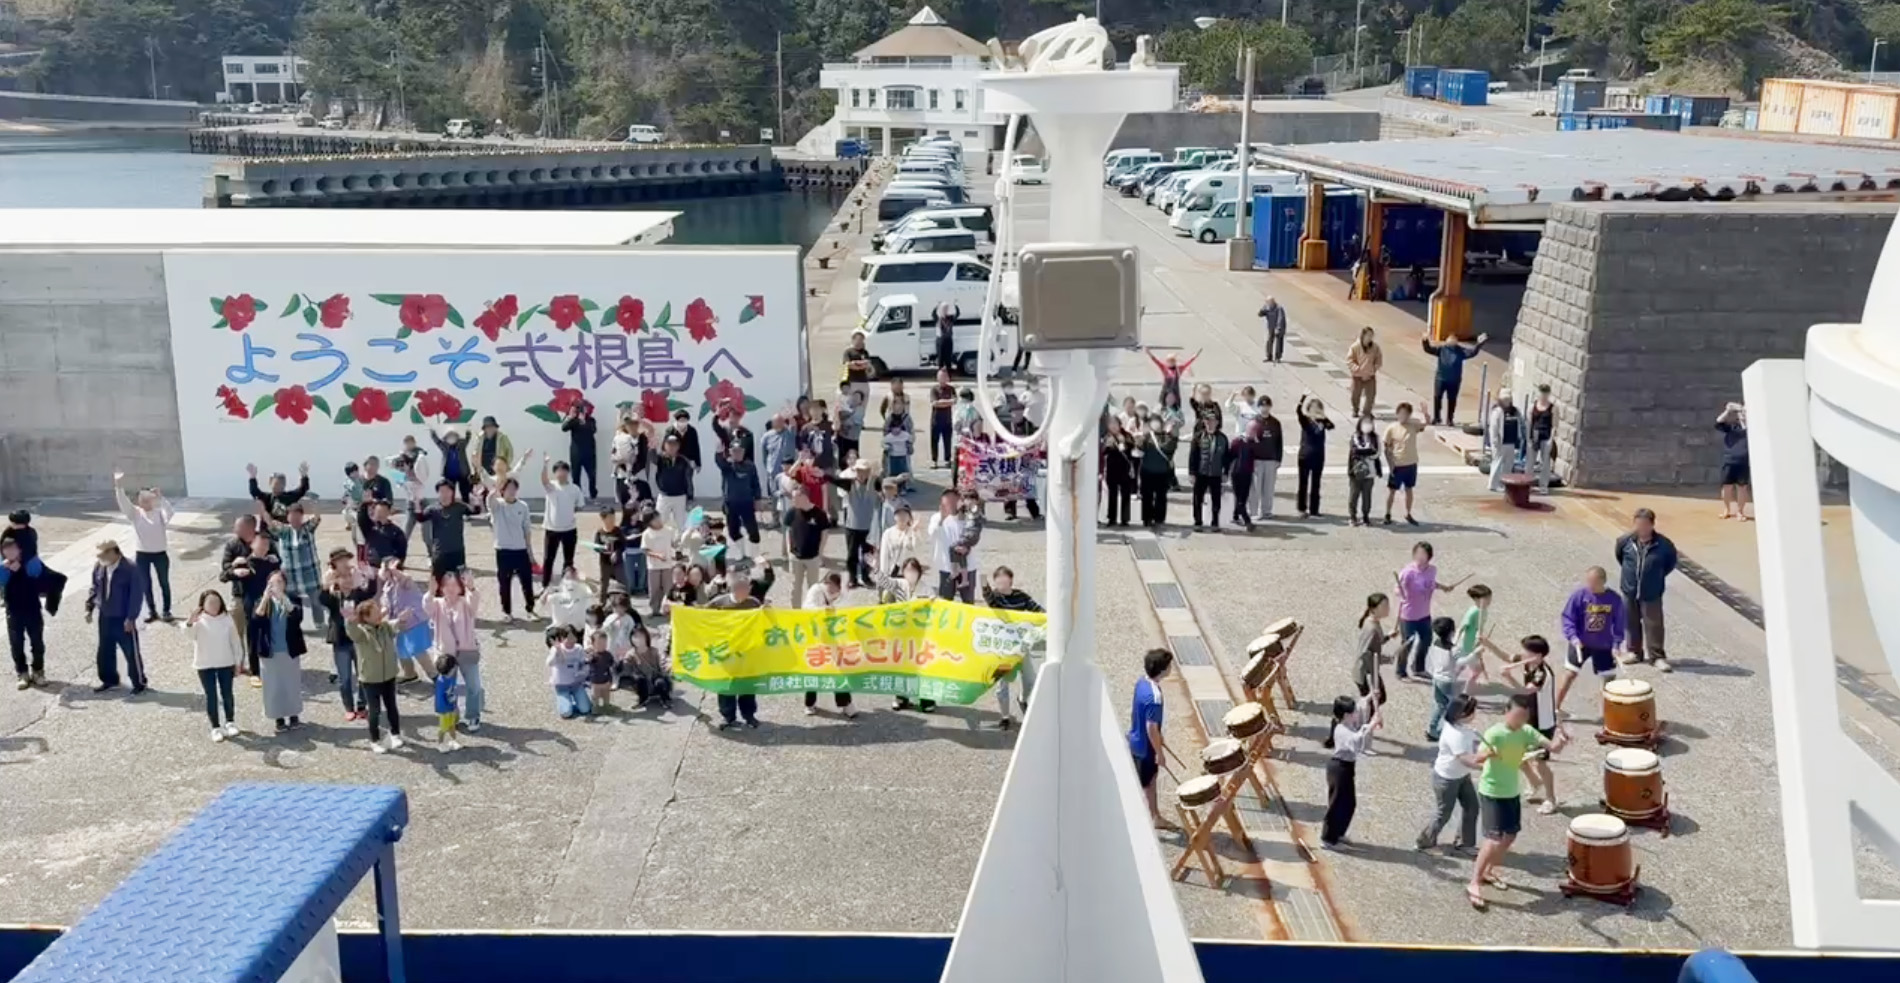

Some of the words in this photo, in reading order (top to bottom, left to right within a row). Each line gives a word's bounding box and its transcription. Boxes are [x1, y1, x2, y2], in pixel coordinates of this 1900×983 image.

[226, 331, 754, 392] ようこそ式根島へ
